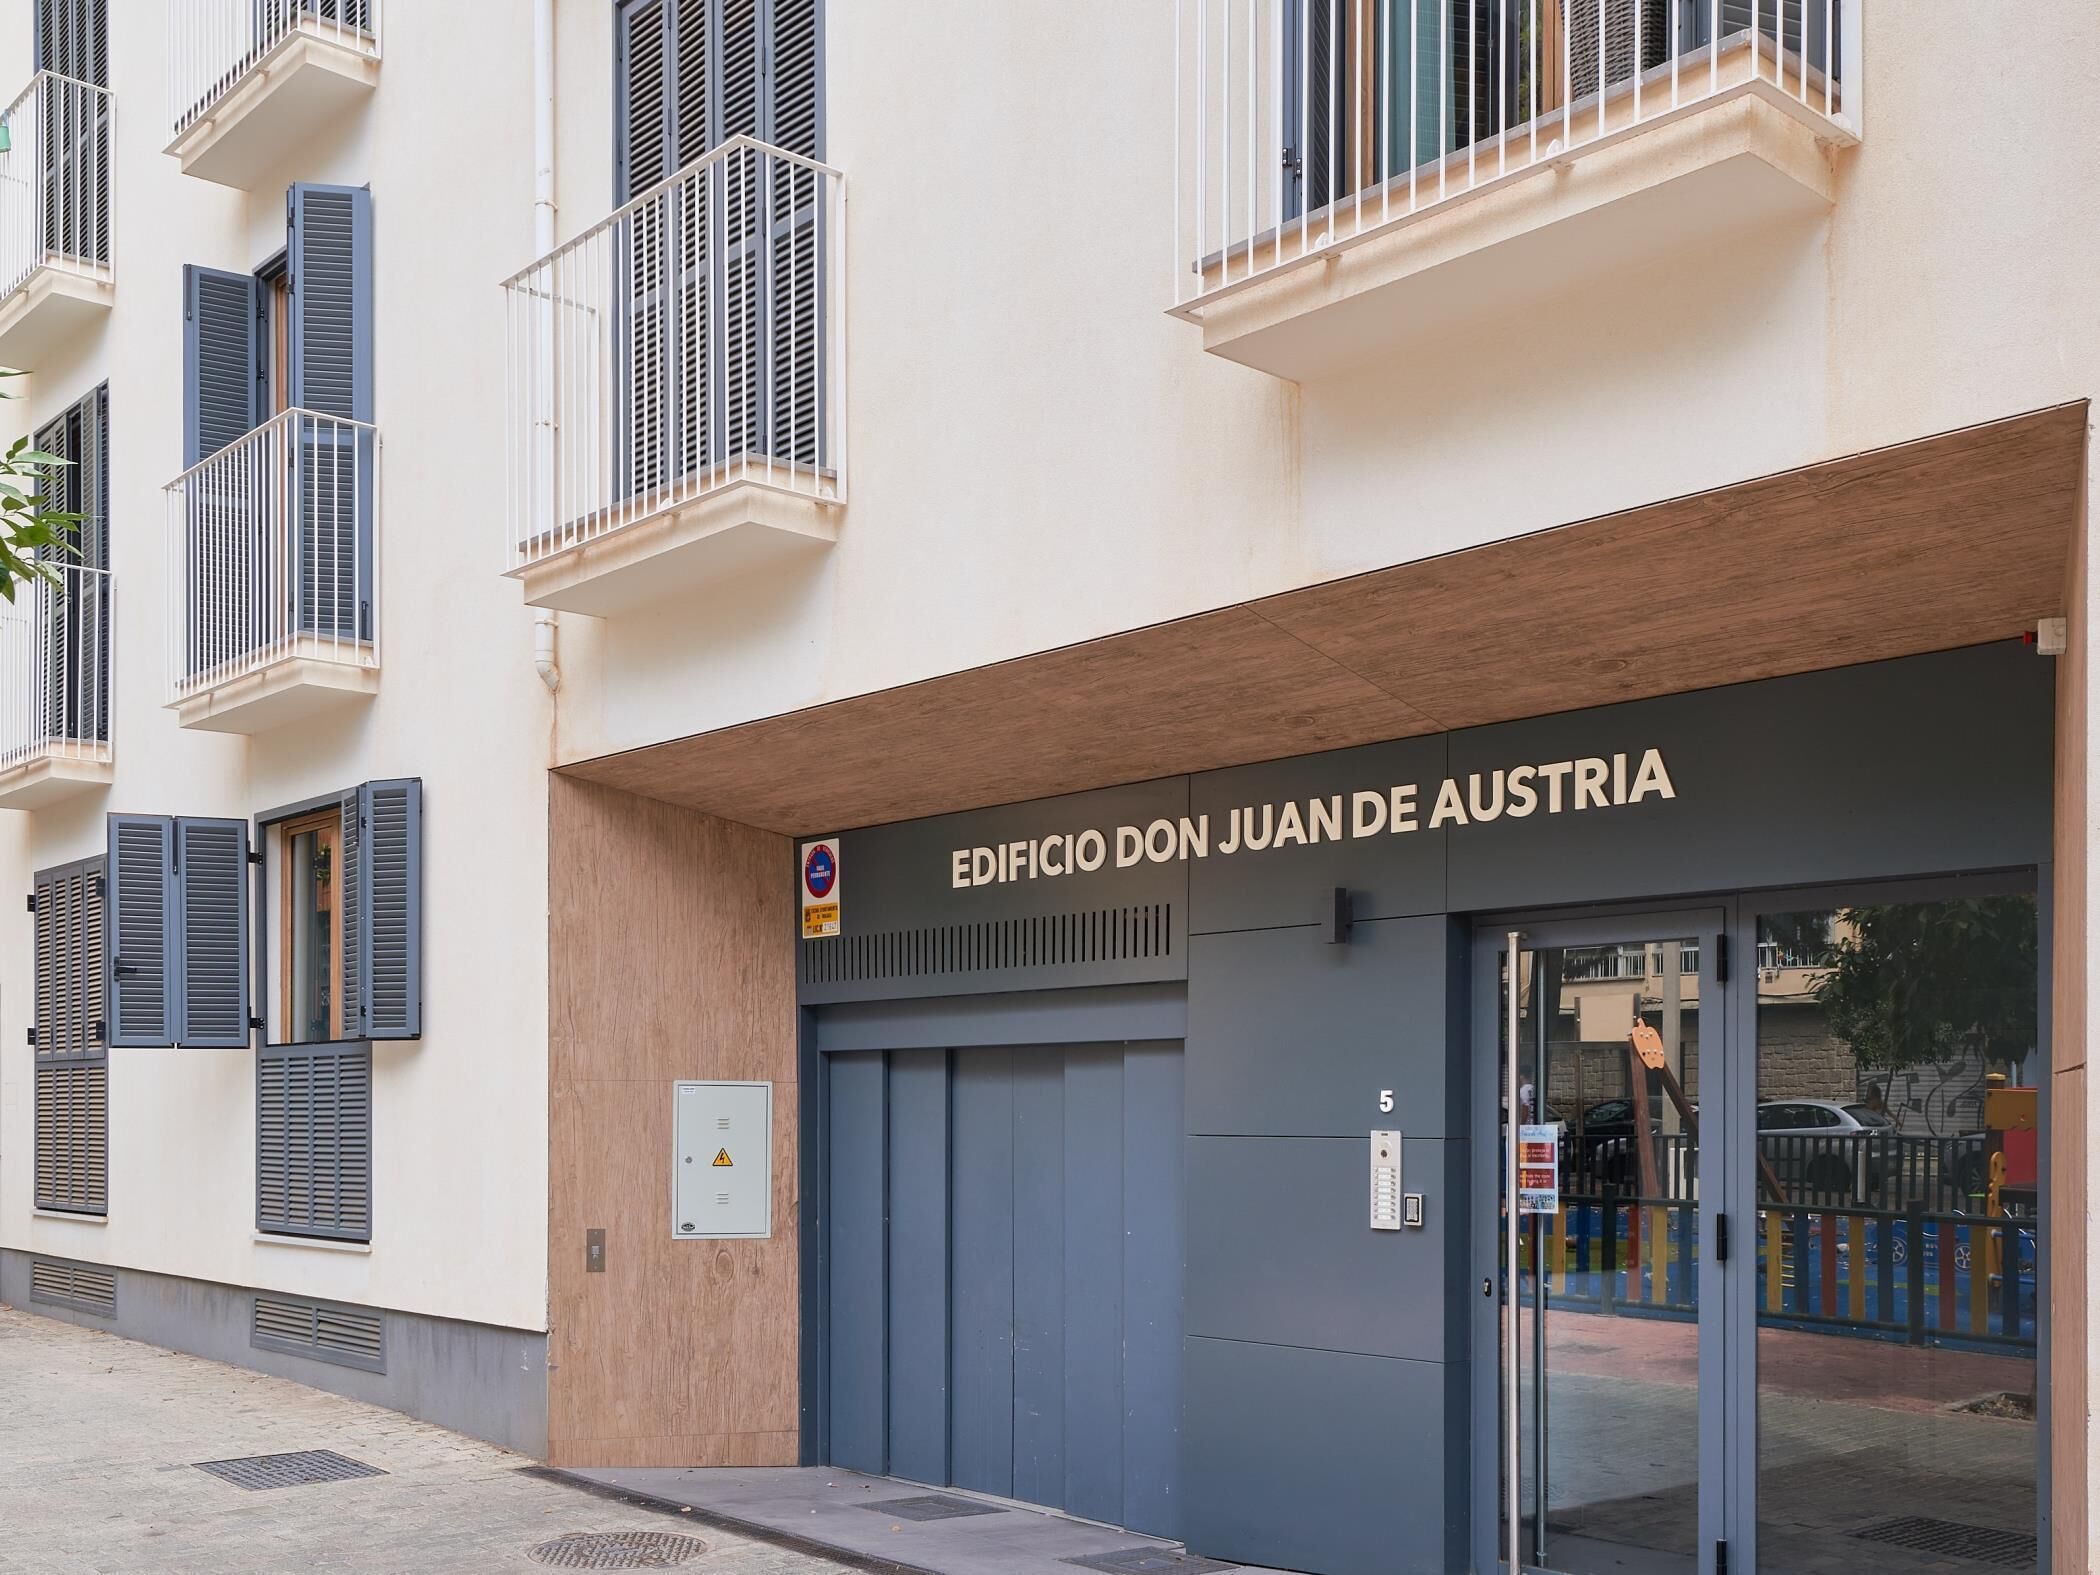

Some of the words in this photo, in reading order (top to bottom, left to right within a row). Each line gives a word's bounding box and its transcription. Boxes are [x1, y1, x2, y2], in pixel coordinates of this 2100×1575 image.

[952, 829, 1107, 888] EDIFICIO
[1116, 814, 1209, 868] DON
[1218, 794, 1343, 855] JUAN
[1352, 783, 1418, 839] DE
[1428, 748, 1677, 829] AUSTRIA
[1379, 1089, 1394, 1113] 5
